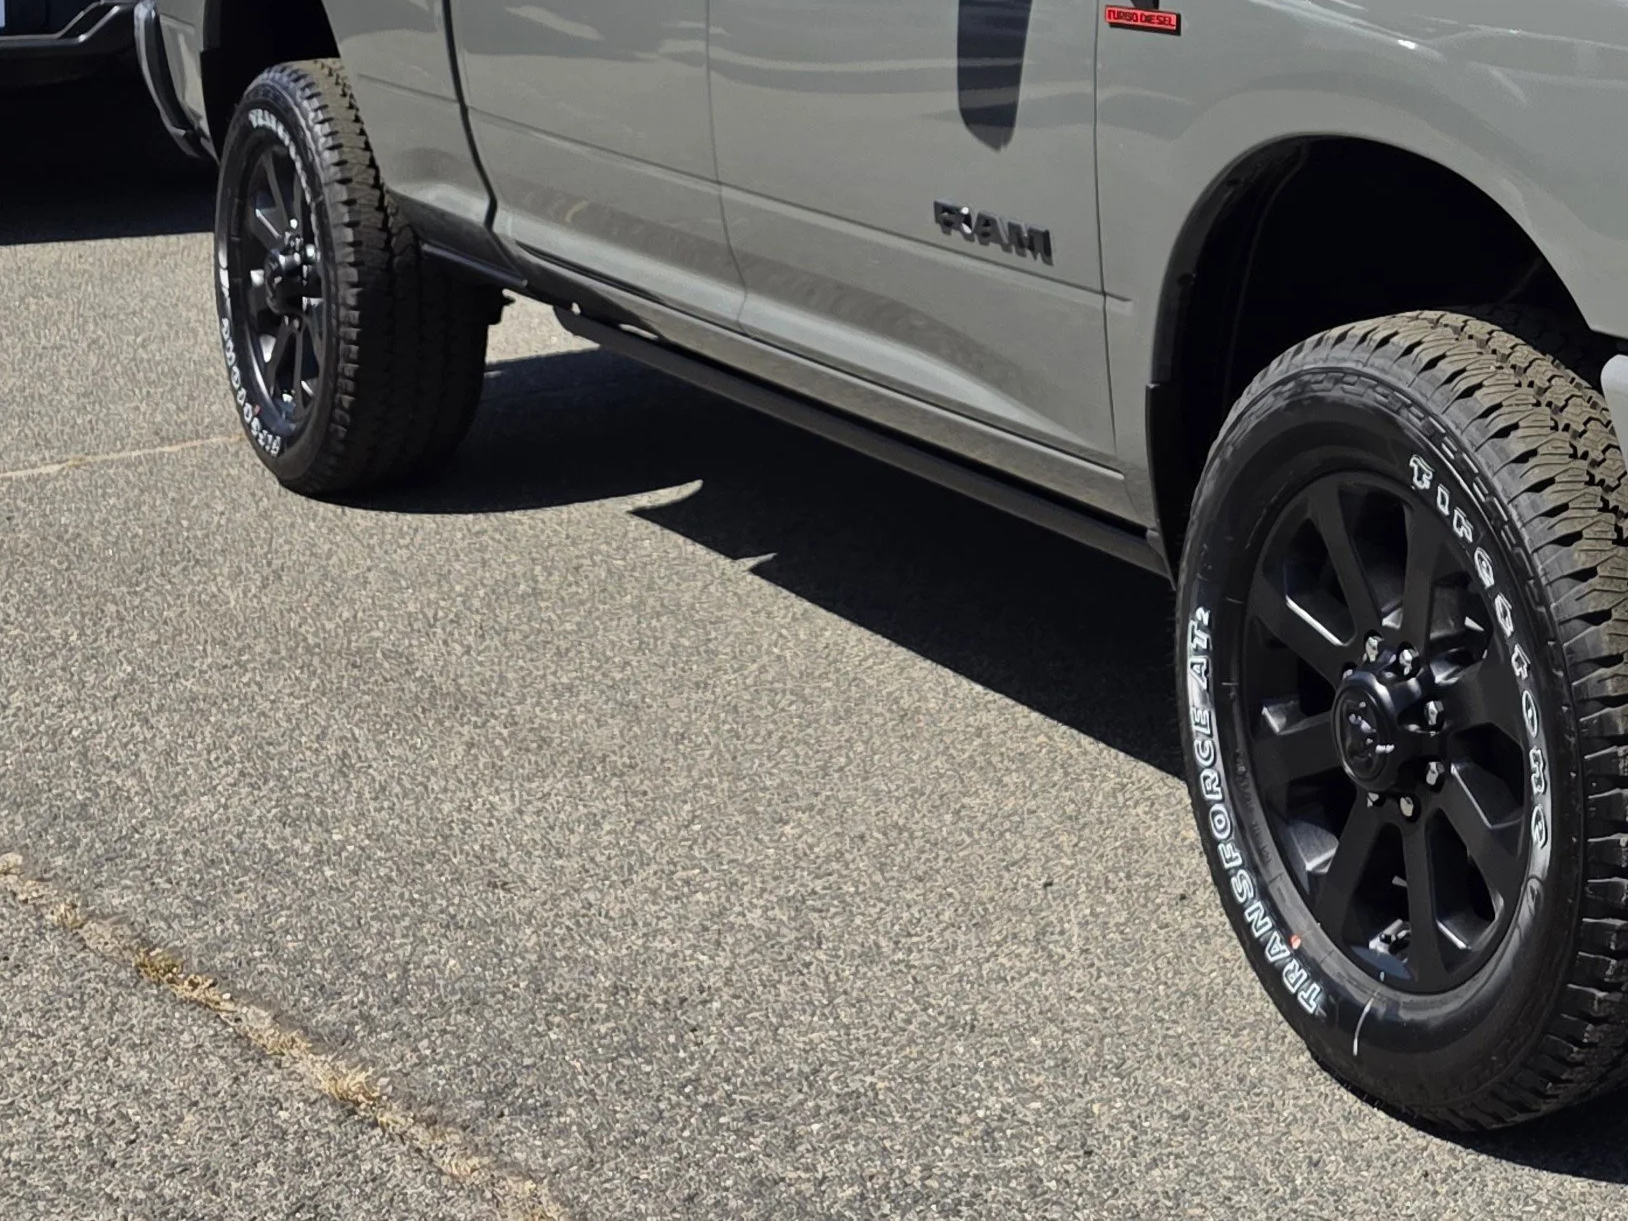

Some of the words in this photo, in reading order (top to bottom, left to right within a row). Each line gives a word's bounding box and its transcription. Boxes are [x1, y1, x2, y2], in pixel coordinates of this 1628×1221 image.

[1107, 9, 1139, 22] TURBO
[1140, 13, 1176, 27] DIESEL
[934, 199, 1053, 266] RAM
[1187, 606, 1212, 691] AT2
[1190, 704, 1328, 1018] TRANSFORCE
